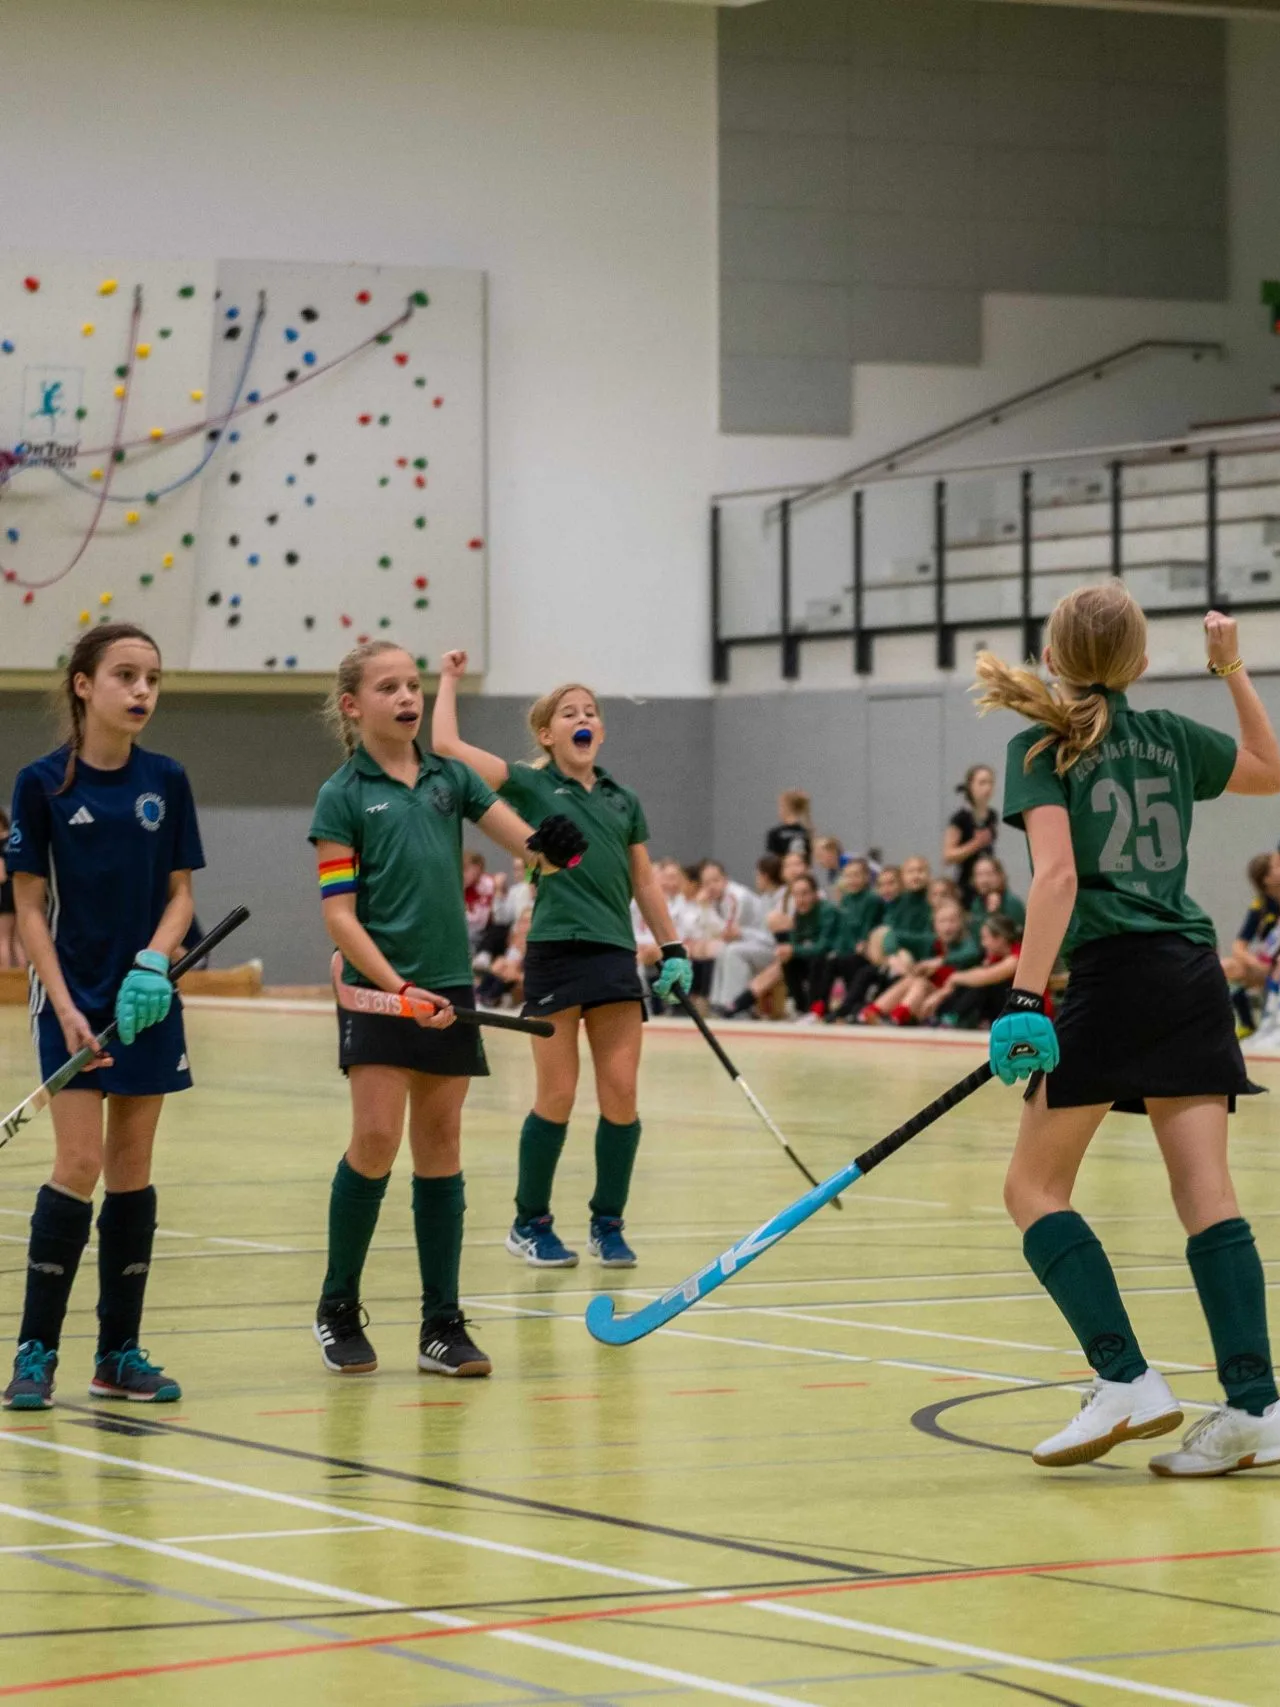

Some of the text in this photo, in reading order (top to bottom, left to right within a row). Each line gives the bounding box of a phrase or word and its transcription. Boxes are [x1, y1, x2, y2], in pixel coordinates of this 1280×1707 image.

[1091, 777, 1182, 873] 25
[354, 988, 402, 1014] Grays
[660, 1214, 787, 1304] TK
